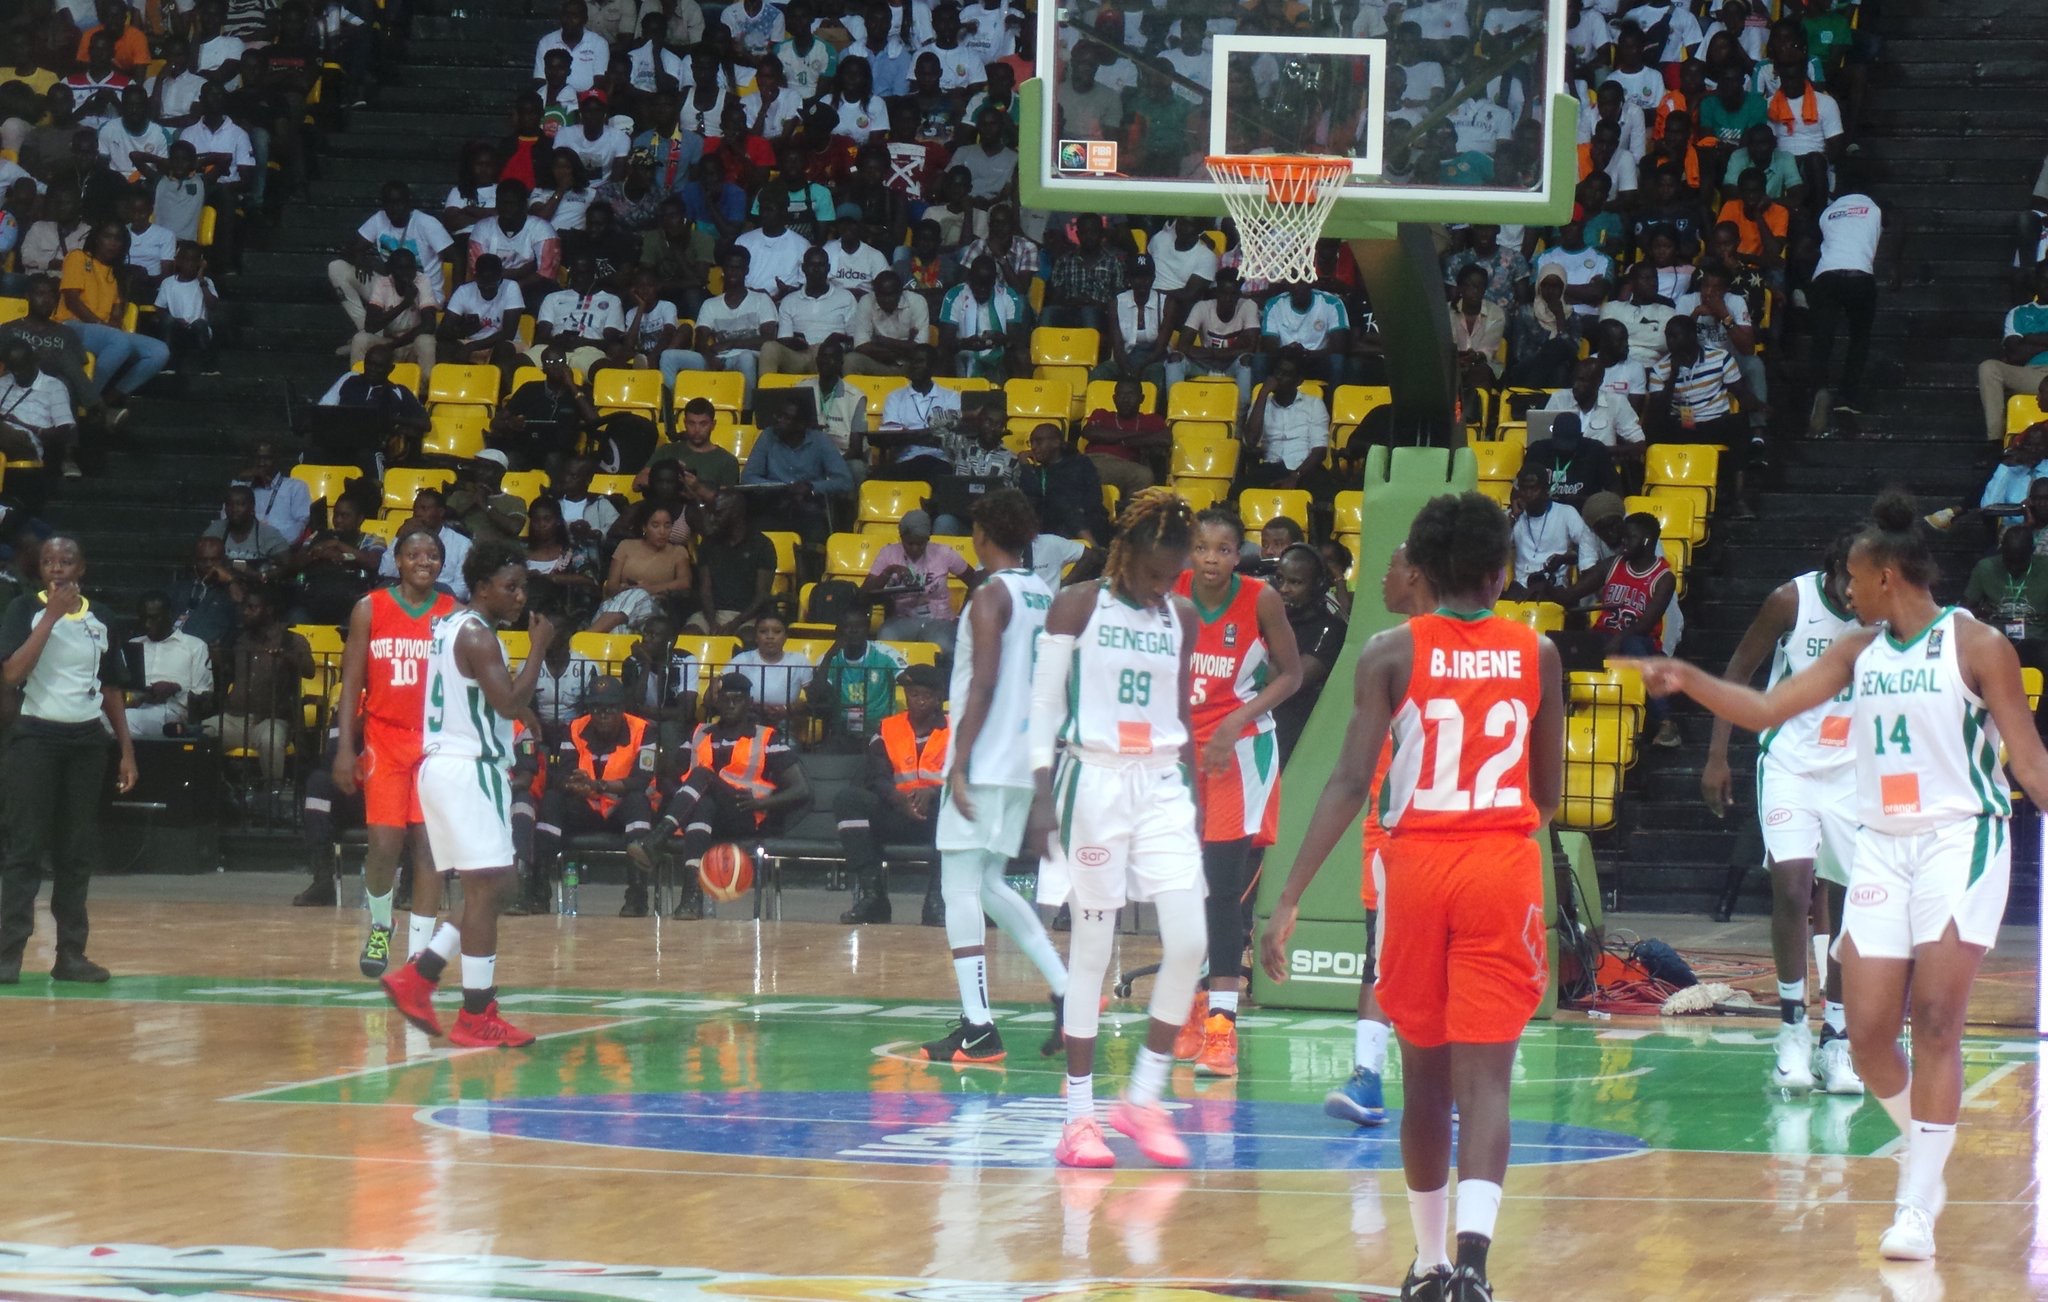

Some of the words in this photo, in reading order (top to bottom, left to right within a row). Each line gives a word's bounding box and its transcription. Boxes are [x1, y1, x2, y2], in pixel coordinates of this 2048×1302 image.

[836, 268, 867, 280] didas
[1605, 583, 1647, 613] BULLS
[1097, 624, 1176, 657] SENEGAL
[391, 658, 418, 687] 10
[1430, 647, 1522, 679] B.IRENE
[1118, 668, 1151, 707] 89
[1861, 668, 1942, 697] SENEGAL
[1819, 737, 1847, 747] orange
[1873, 714, 1912, 755] 14
[1413, 698, 1529, 811] 12
[1769, 811, 1788, 822] sar
[1884, 803, 1918, 814] orange
[1081, 851, 1105, 861] sar
[1853, 890, 1881, 900] sar
